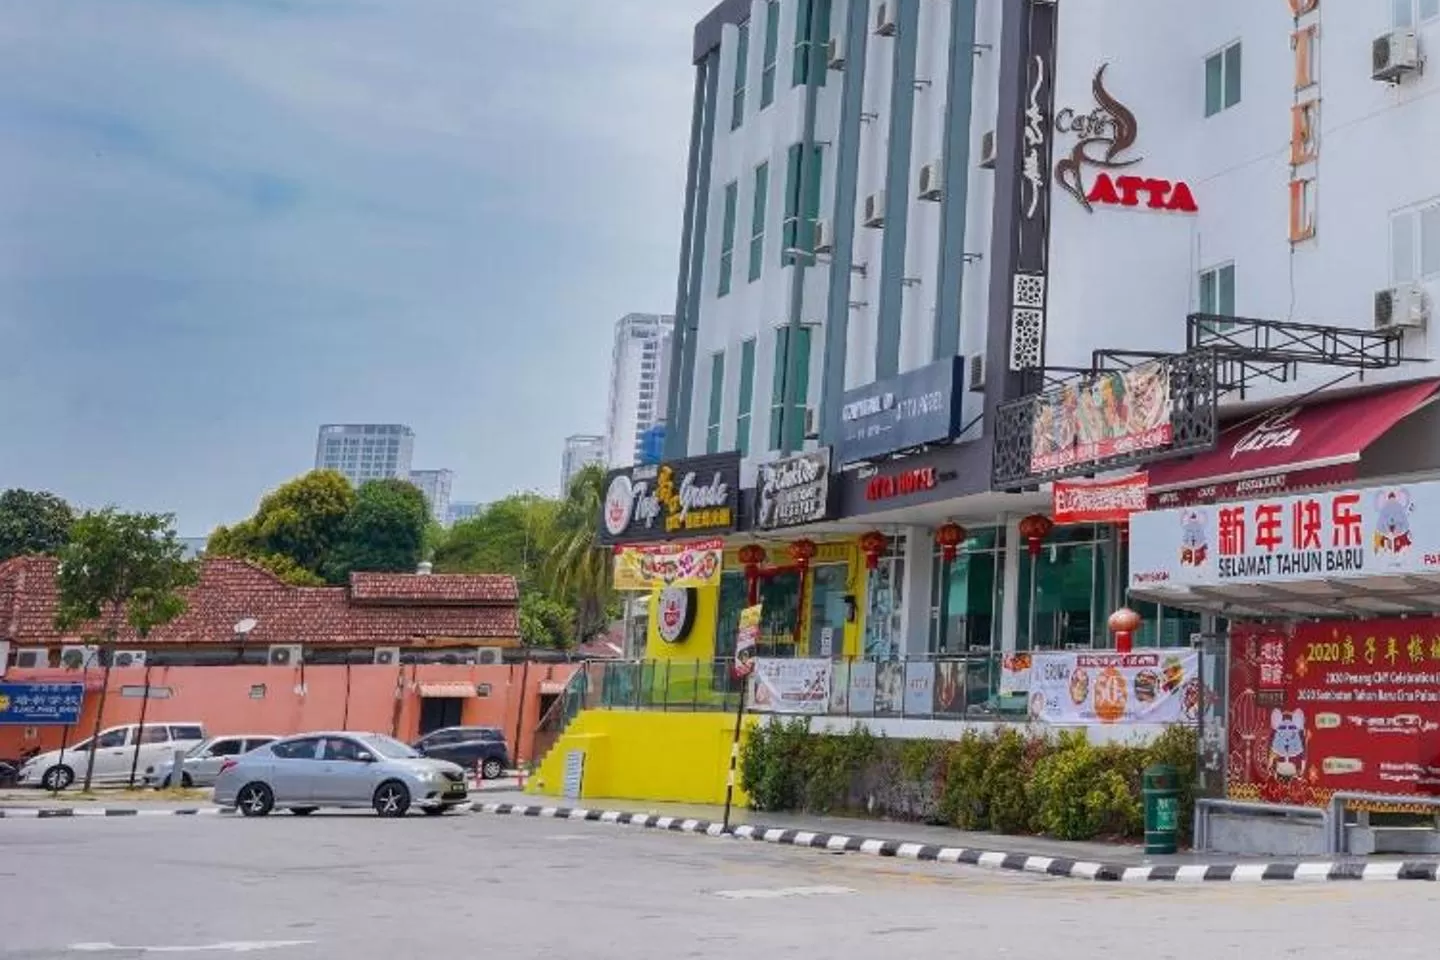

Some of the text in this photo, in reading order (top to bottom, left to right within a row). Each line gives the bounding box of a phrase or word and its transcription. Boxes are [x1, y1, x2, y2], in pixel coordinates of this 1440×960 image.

[1086, 172, 1199, 212] ATTA
[898, 466, 937, 494] HOTEL
[1218, 493, 1363, 557] 新年快乐
[1218, 546, 1364, 578] SELAMAT TAHUN BARU
